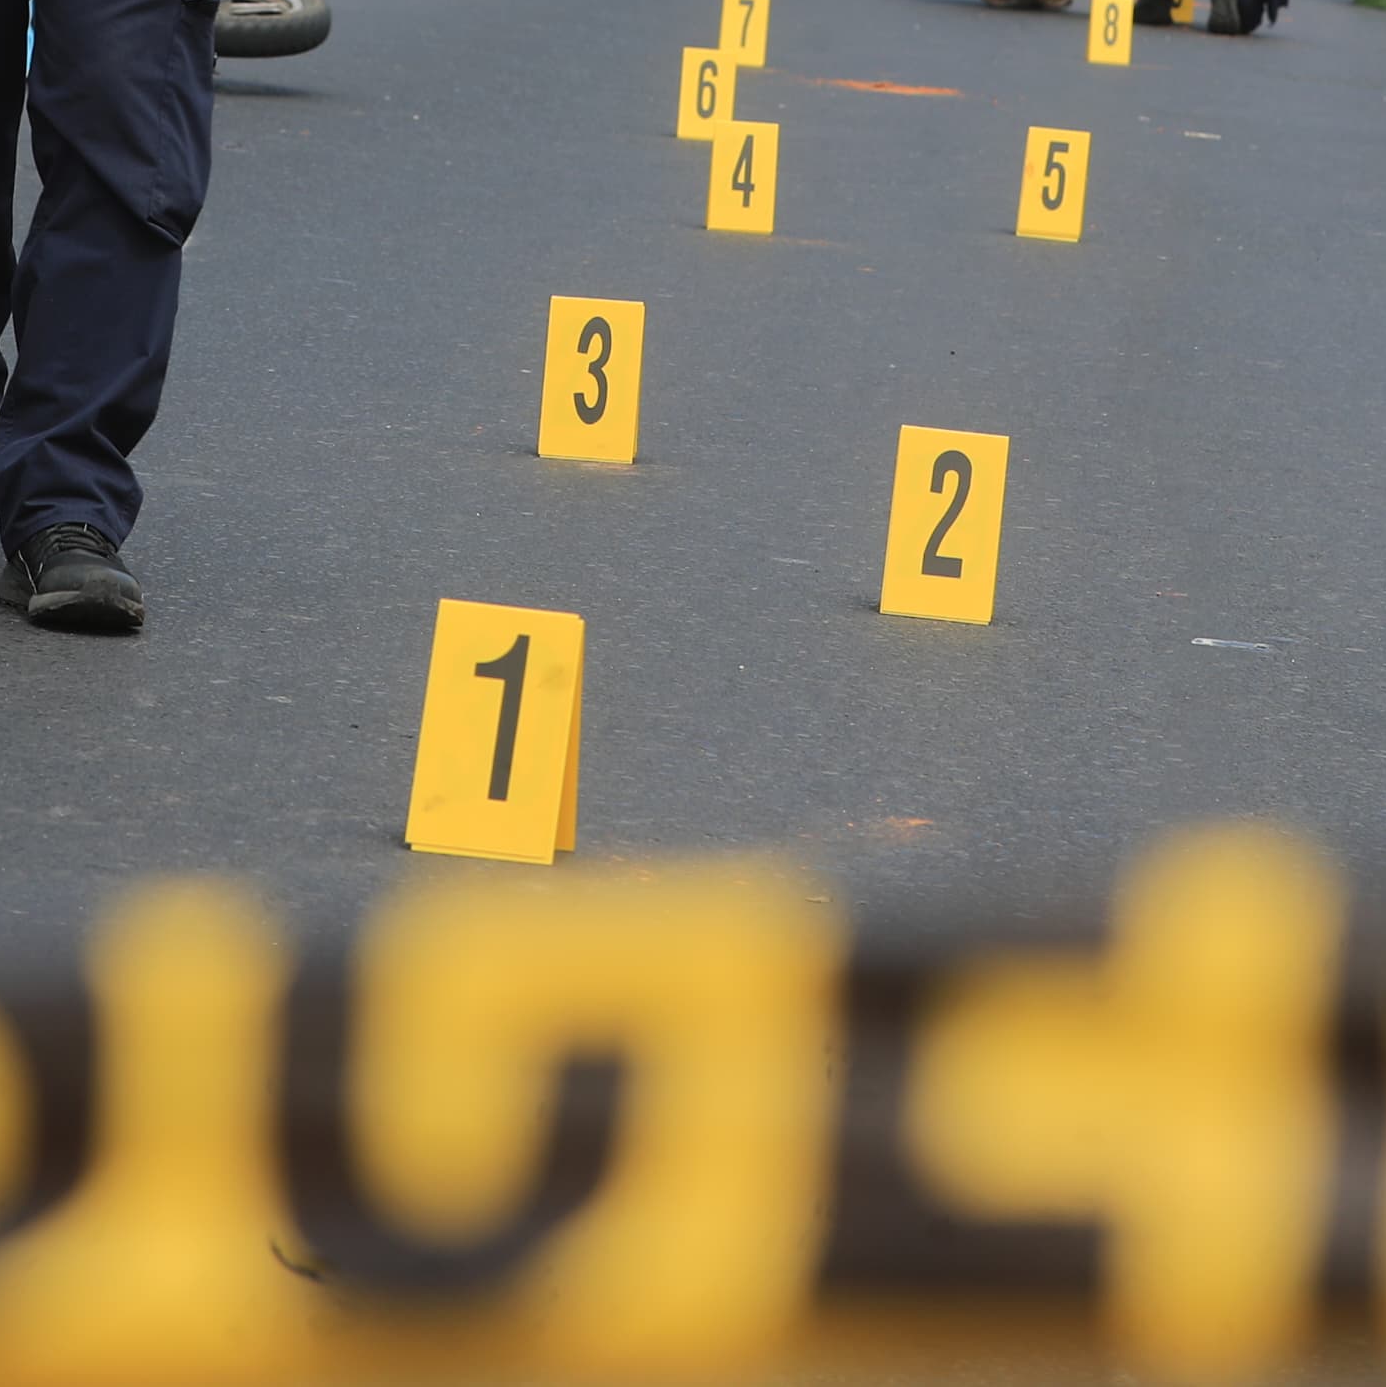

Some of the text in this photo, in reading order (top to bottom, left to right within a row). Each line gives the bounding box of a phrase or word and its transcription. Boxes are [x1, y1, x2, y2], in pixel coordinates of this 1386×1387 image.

[1103, 2, 1120, 47] 8
[696, 59, 718, 118] 6
[731, 134, 755, 208] 4
[1041, 141, 1070, 211] 5
[573, 316, 612, 425] 3
[921, 449, 973, 579] 2
[474, 634, 530, 802] 1
